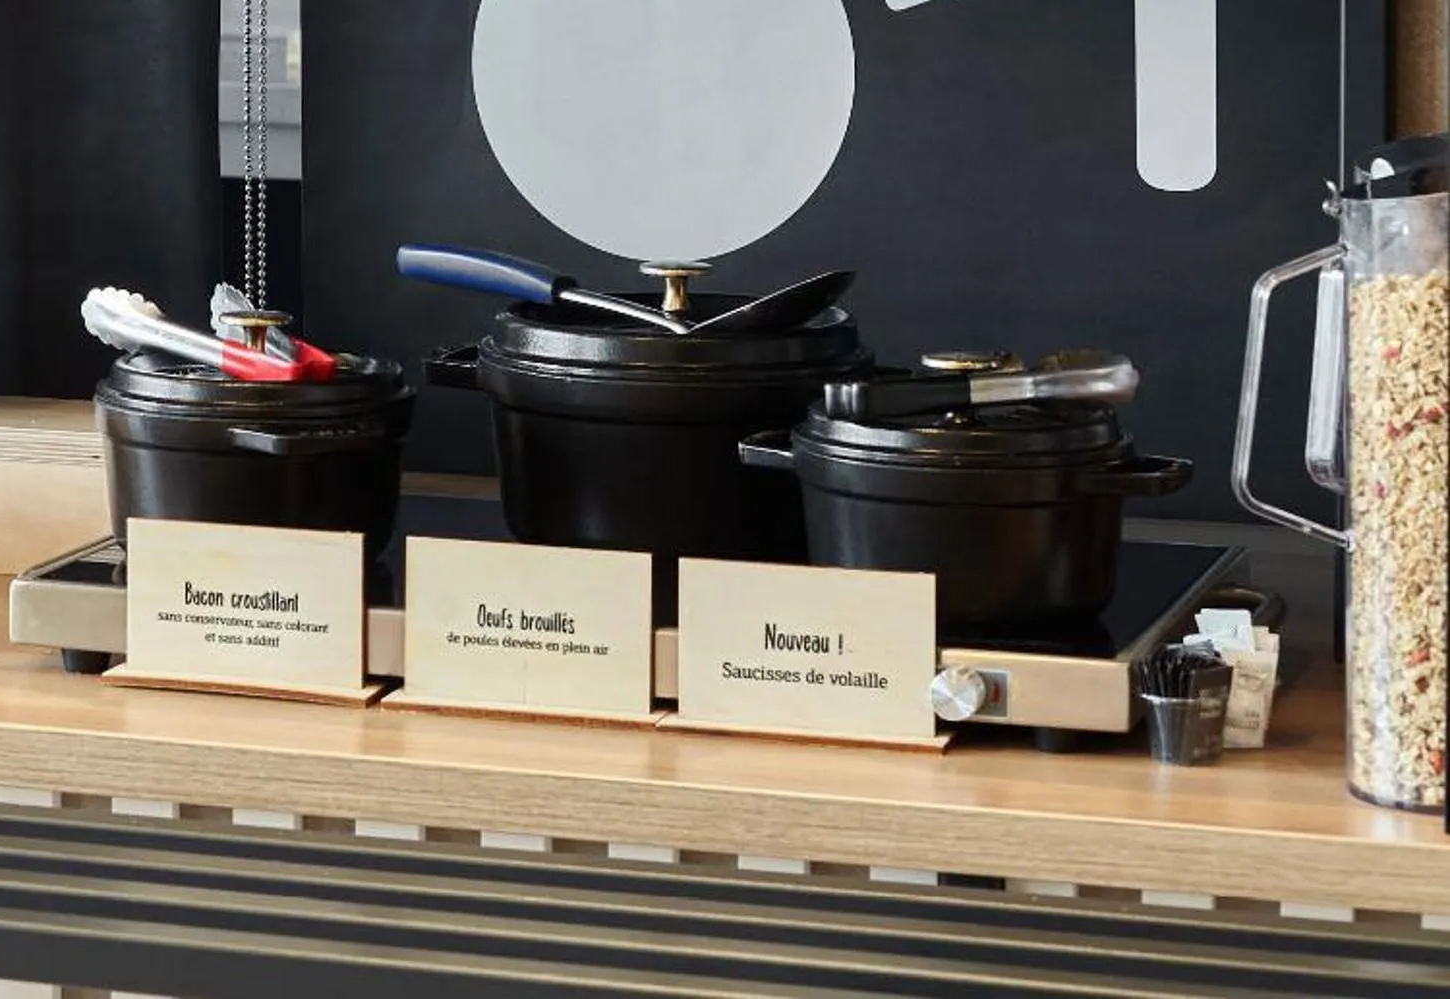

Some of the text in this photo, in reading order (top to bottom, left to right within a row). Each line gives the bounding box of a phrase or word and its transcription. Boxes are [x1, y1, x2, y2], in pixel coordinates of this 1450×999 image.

[184, 581, 224, 607] Bacon
[157, 611, 182, 622] sans
[257, 620, 283, 631] sans
[285, 620, 330, 634] colorant
[477, 603, 575, 634] Oeufs brouillés
[204, 632, 280, 648] et sans additif
[446, 631, 609, 656] de poules élevées en plein air
[764, 622, 844, 655] Nouveau !
[721, 661, 889, 690] Saucisses de volaille
